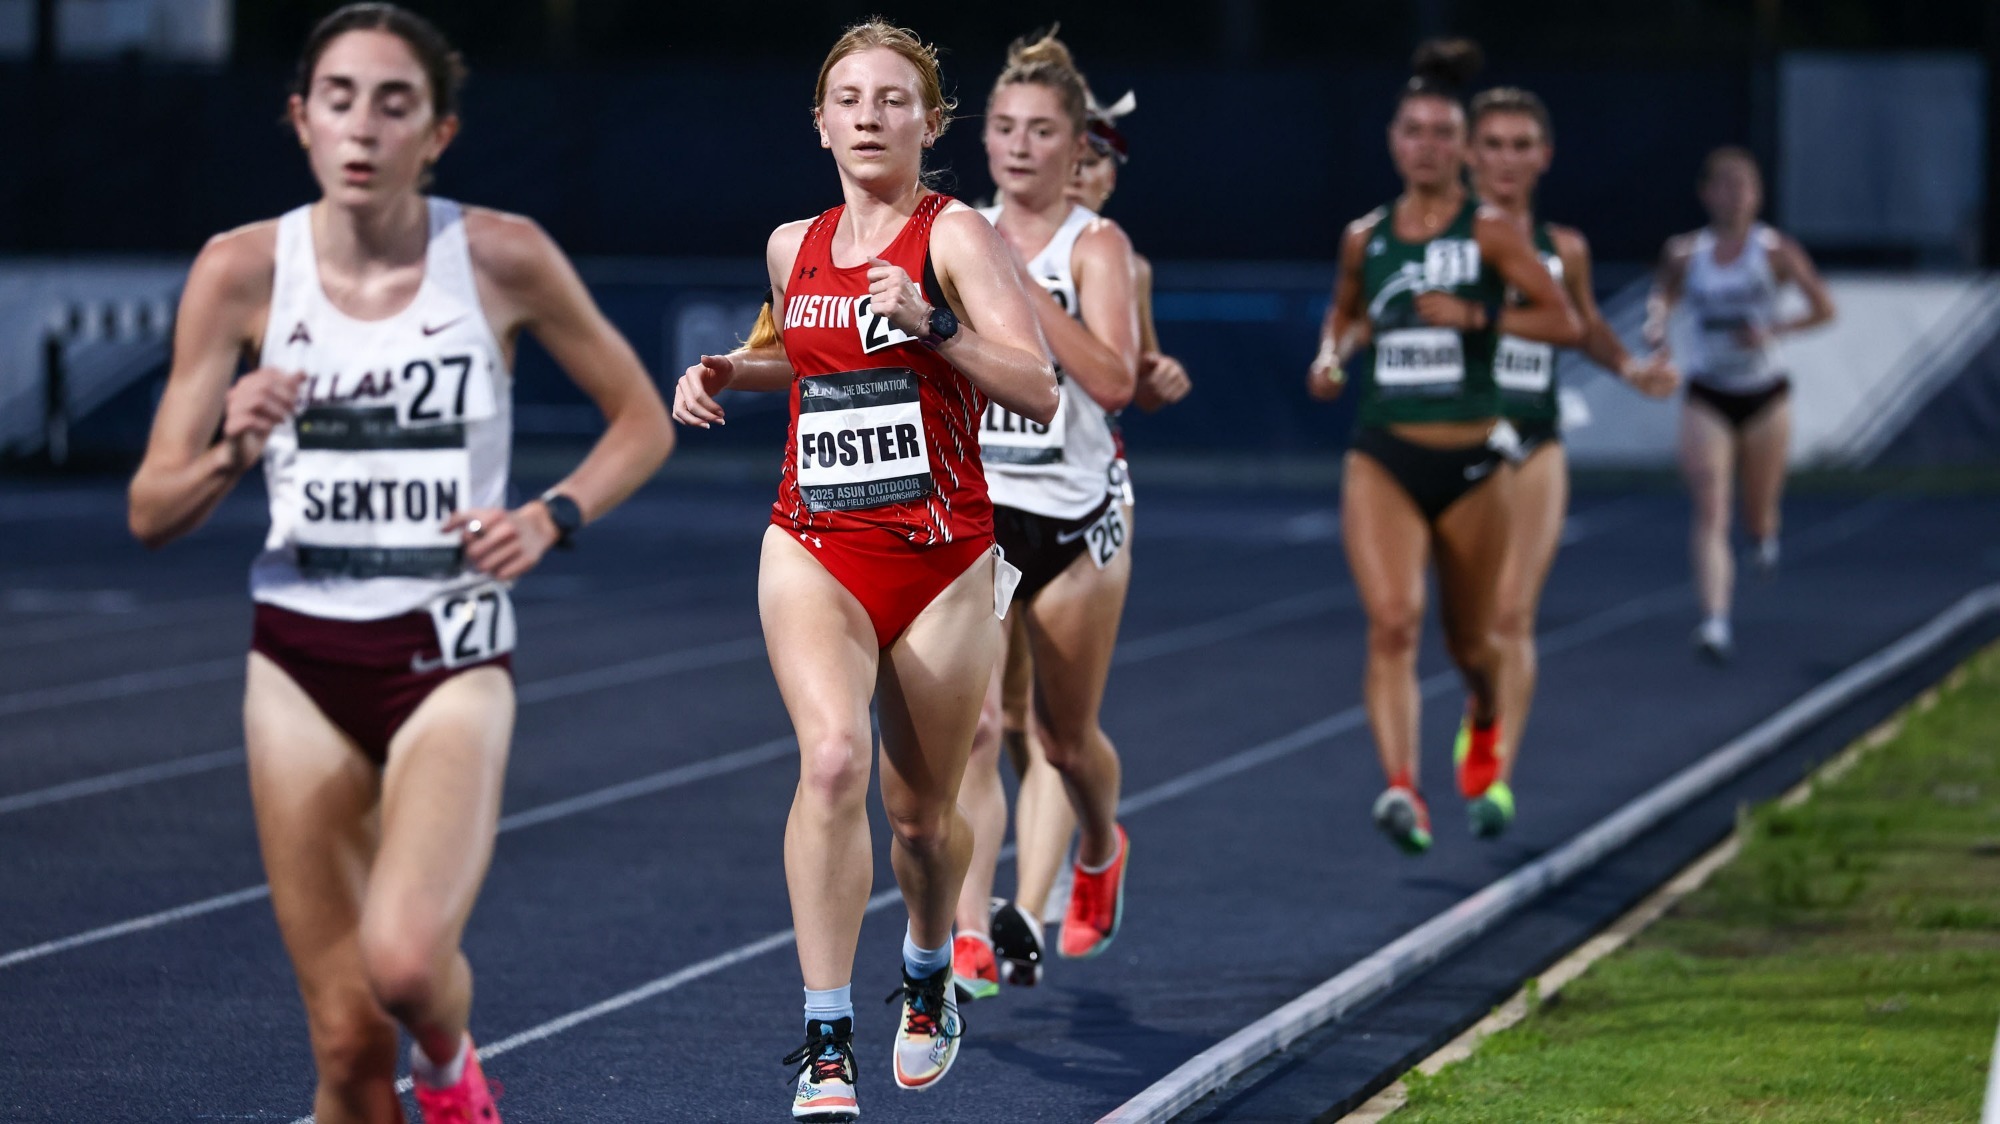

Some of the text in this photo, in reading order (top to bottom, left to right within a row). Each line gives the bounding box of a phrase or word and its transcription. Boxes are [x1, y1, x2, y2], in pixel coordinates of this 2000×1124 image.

[784, 294, 854, 331] AUSTIN
[402, 355, 472, 420] 27
[802, 386, 833, 399] ASUN
[842, 379, 911, 397] THE DESTINATION.
[802, 423, 920, 470] FOSTER
[303, 480, 459, 523] SEXTON
[810, 478, 920, 501] 2025 ASUN OUTDOOR
[810, 489, 921, 509] TRACK AND FIELD CHAMPIONSHIPS
[1092, 510, 1124, 564] 26
[445, 592, 499, 660] 27
